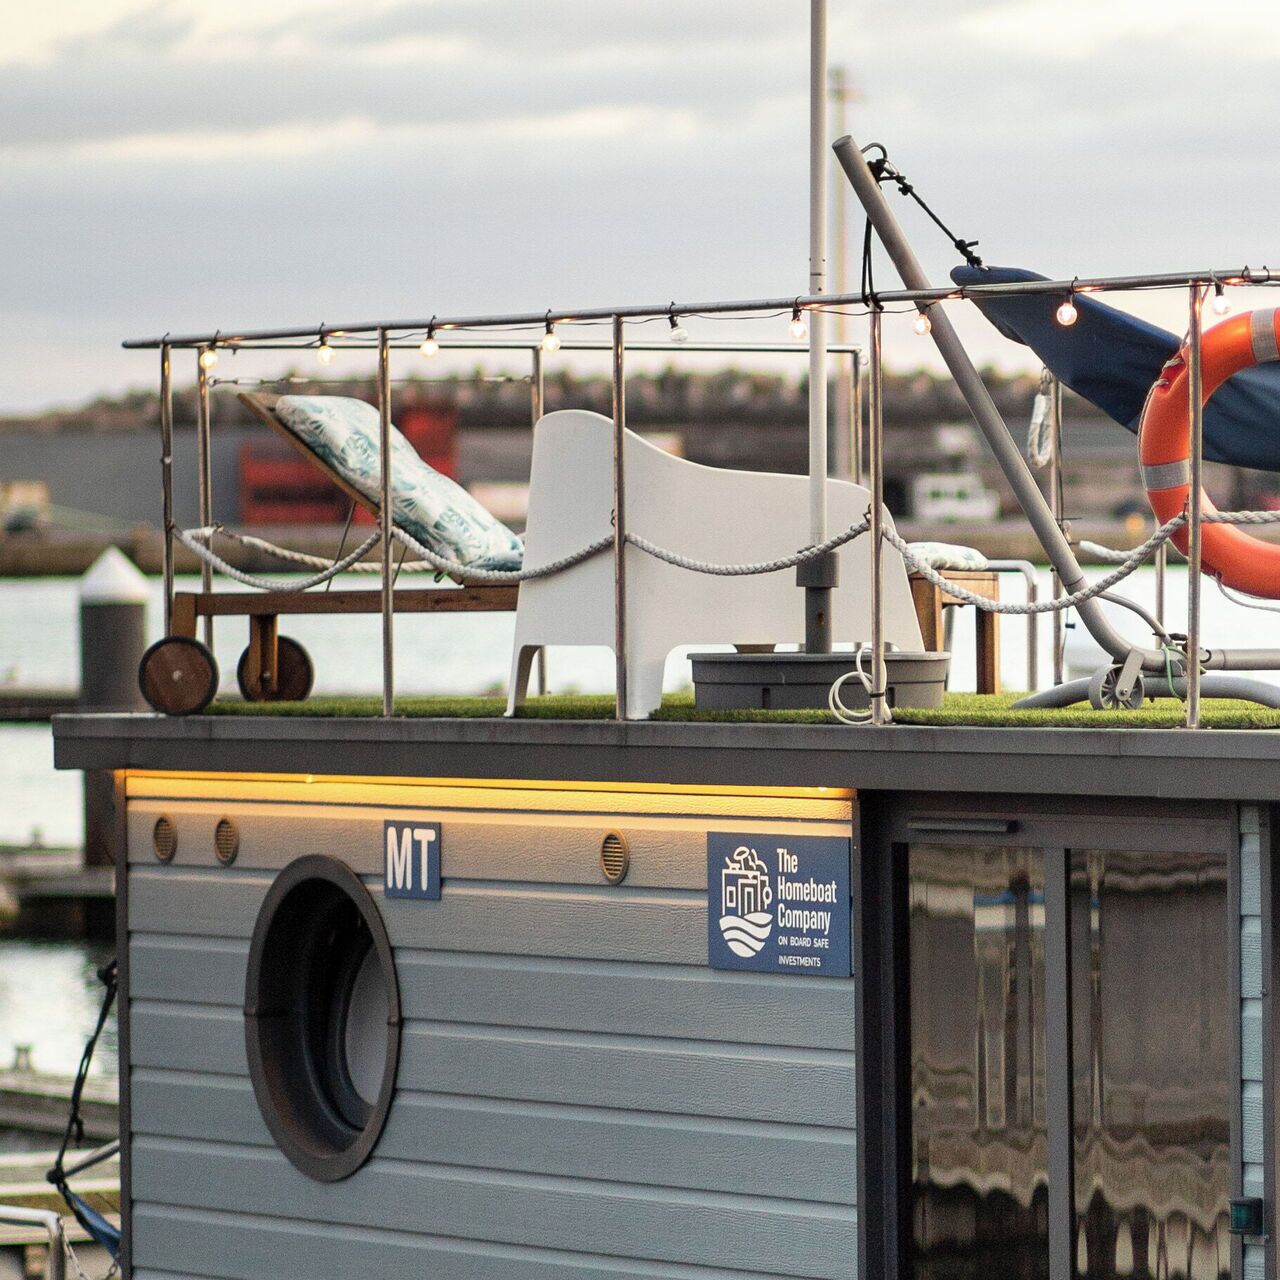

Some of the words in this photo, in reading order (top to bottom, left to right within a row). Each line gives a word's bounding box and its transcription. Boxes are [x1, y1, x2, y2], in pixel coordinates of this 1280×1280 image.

[386, 826, 436, 891] MT
[776, 847, 798, 874] The
[777, 875, 837, 904] Homeboat
[777, 903, 831, 935] Company
[778, 935, 788, 946] ON
[790, 936, 812, 948] BOARD
[813, 937, 830, 949] SAFE
[778, 955, 821, 967] INVESTMENTS
